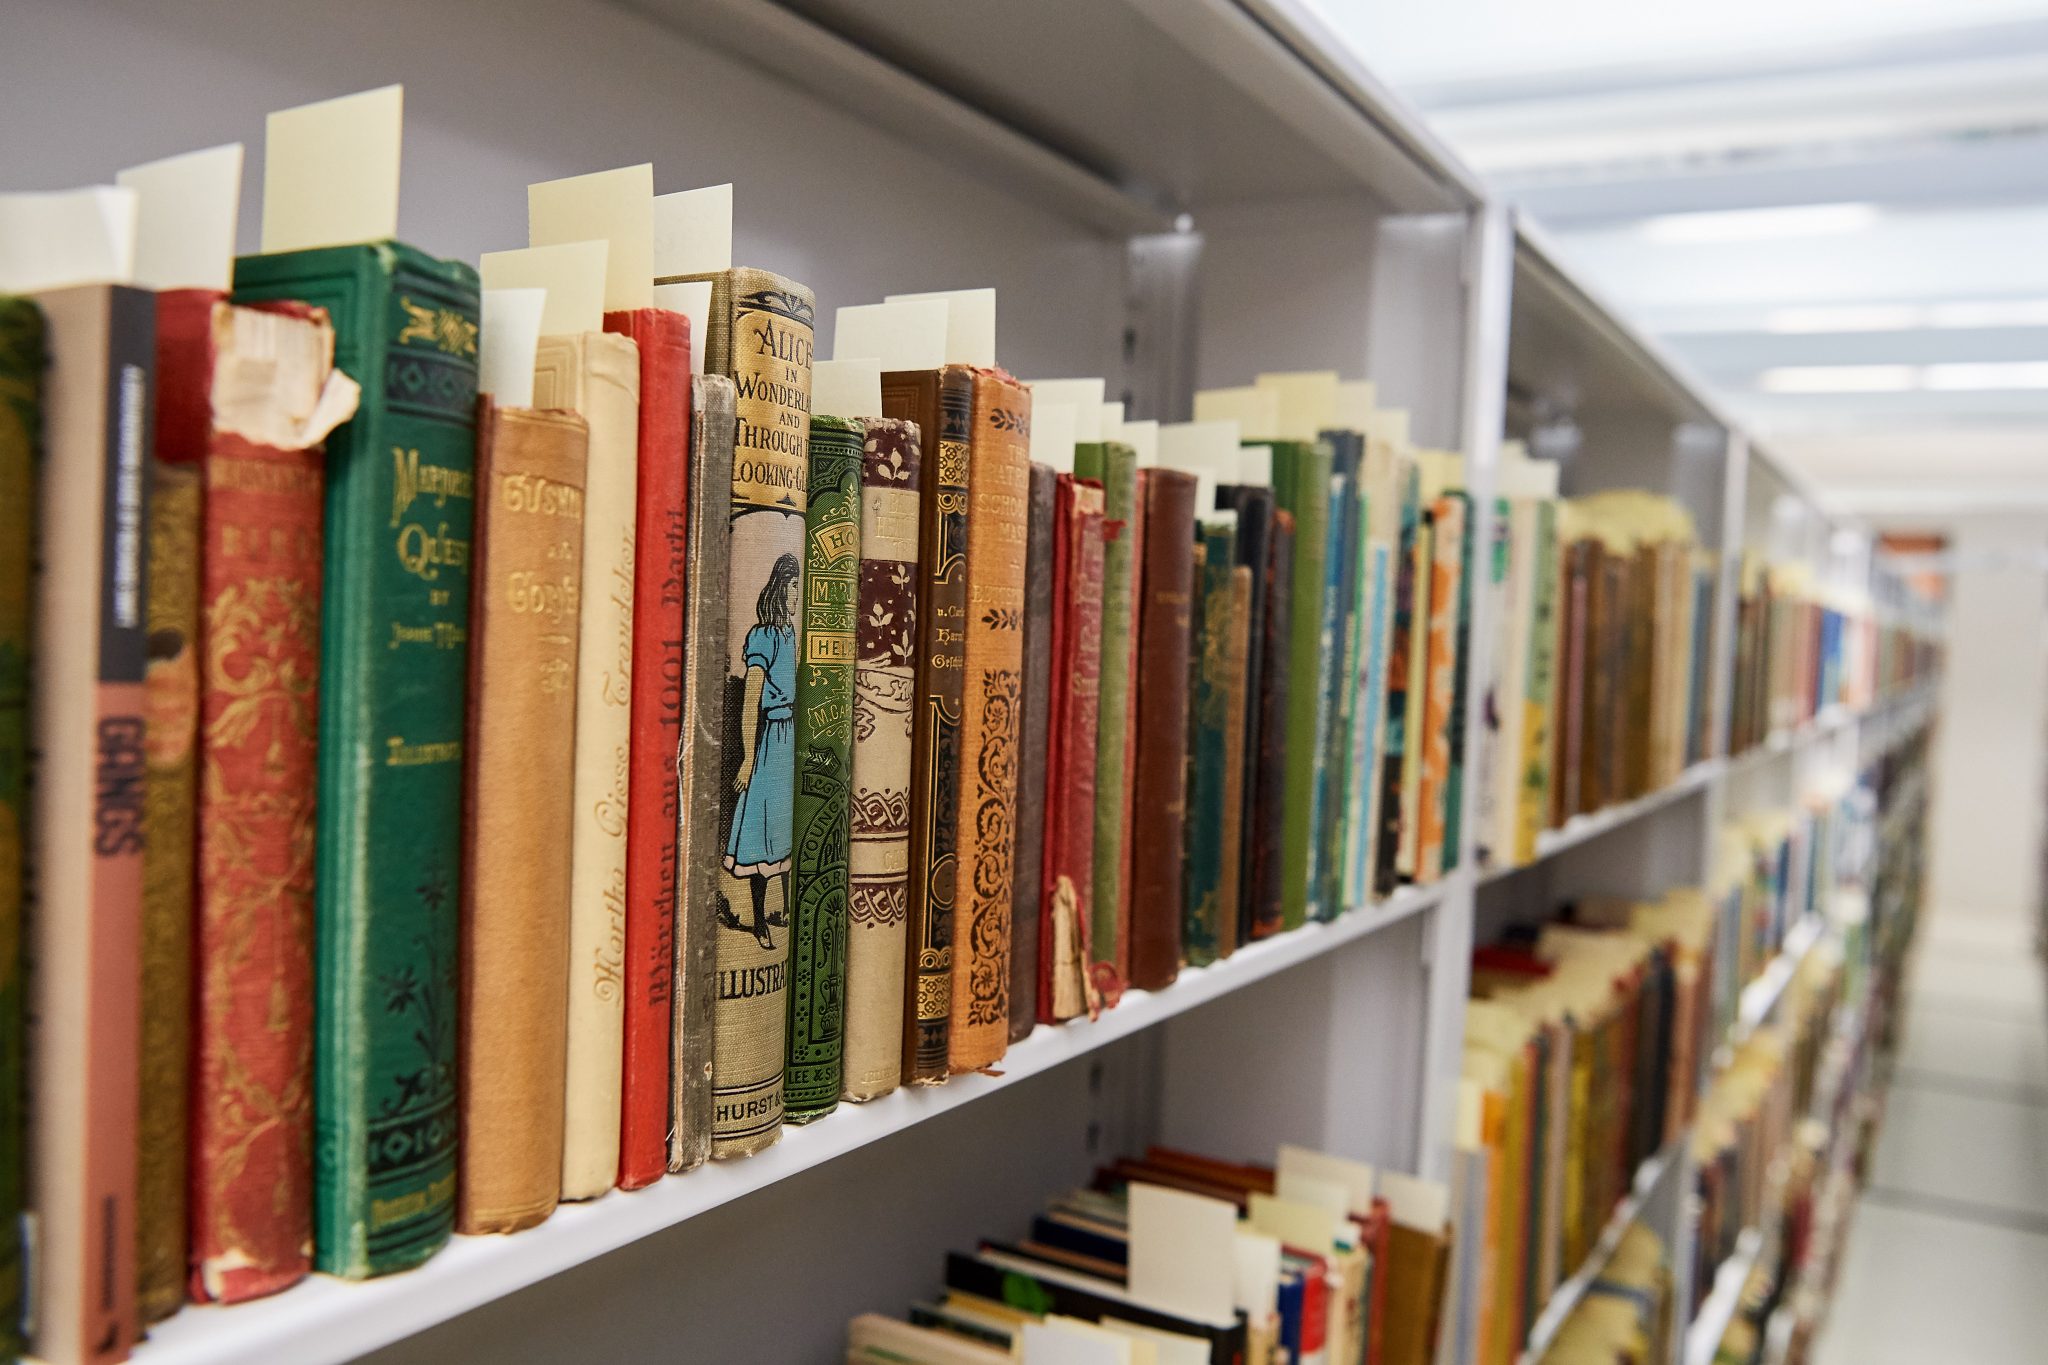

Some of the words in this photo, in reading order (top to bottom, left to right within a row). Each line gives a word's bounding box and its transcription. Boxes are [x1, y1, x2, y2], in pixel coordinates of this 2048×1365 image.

[753, 318, 813, 370] ALICE
[785, 367, 798, 383] IN
[735, 371, 811, 415] WONDERLA
[779, 412, 800, 429] AND
[735, 416, 803, 458] THROUGH
[731, 460, 808, 493] LOOKING-GL
[830, 529, 858, 549] HO
[819, 640, 854, 656] HELP
[658, 639, 683, 729] 1001
[96, 715, 145, 859] GANGS
[788, 1069, 810, 1085] LEE
[814, 1068, 824, 1082] &
[716, 1094, 773, 1122] HURST
